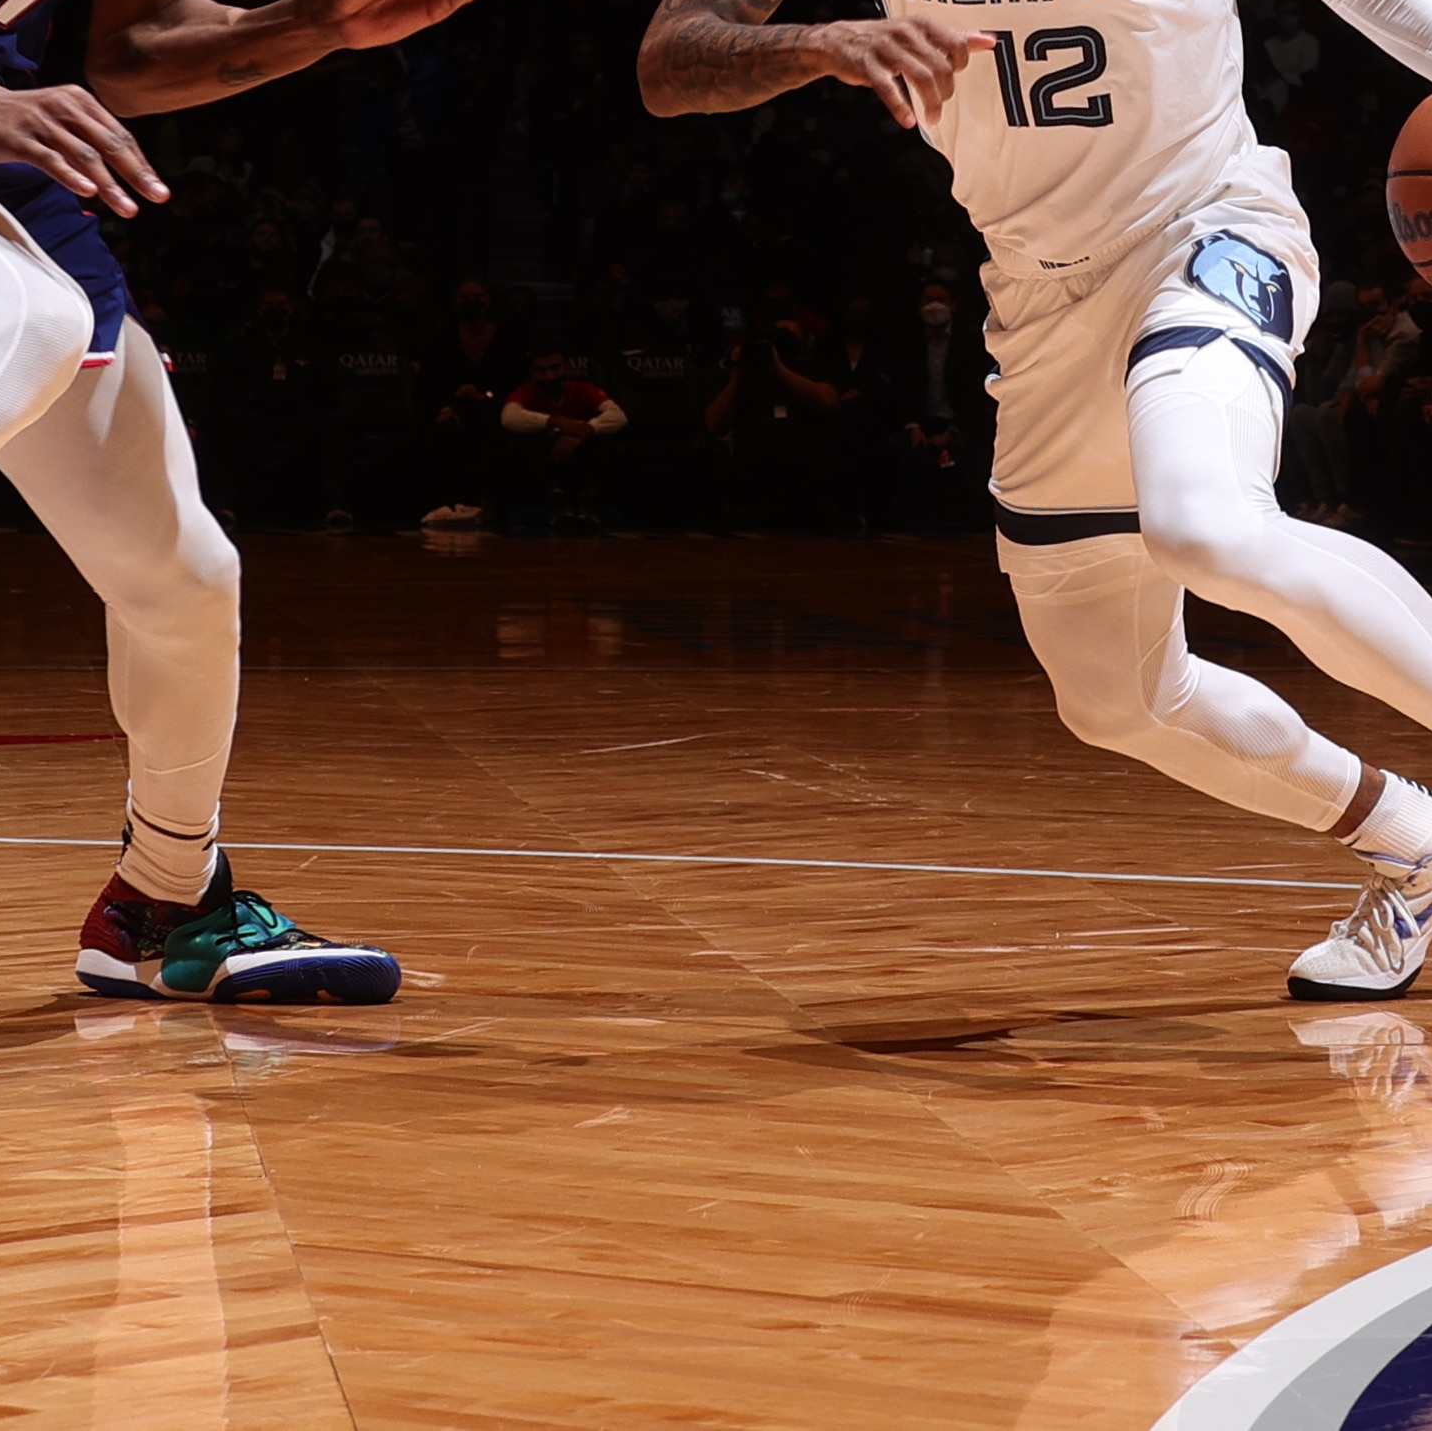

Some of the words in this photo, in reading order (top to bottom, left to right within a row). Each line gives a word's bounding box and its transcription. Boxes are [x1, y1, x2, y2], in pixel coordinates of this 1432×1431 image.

[979, 25, 1114, 127] 12
[338, 353, 398, 369] QATAR
[626, 356, 686, 371] QATAR
